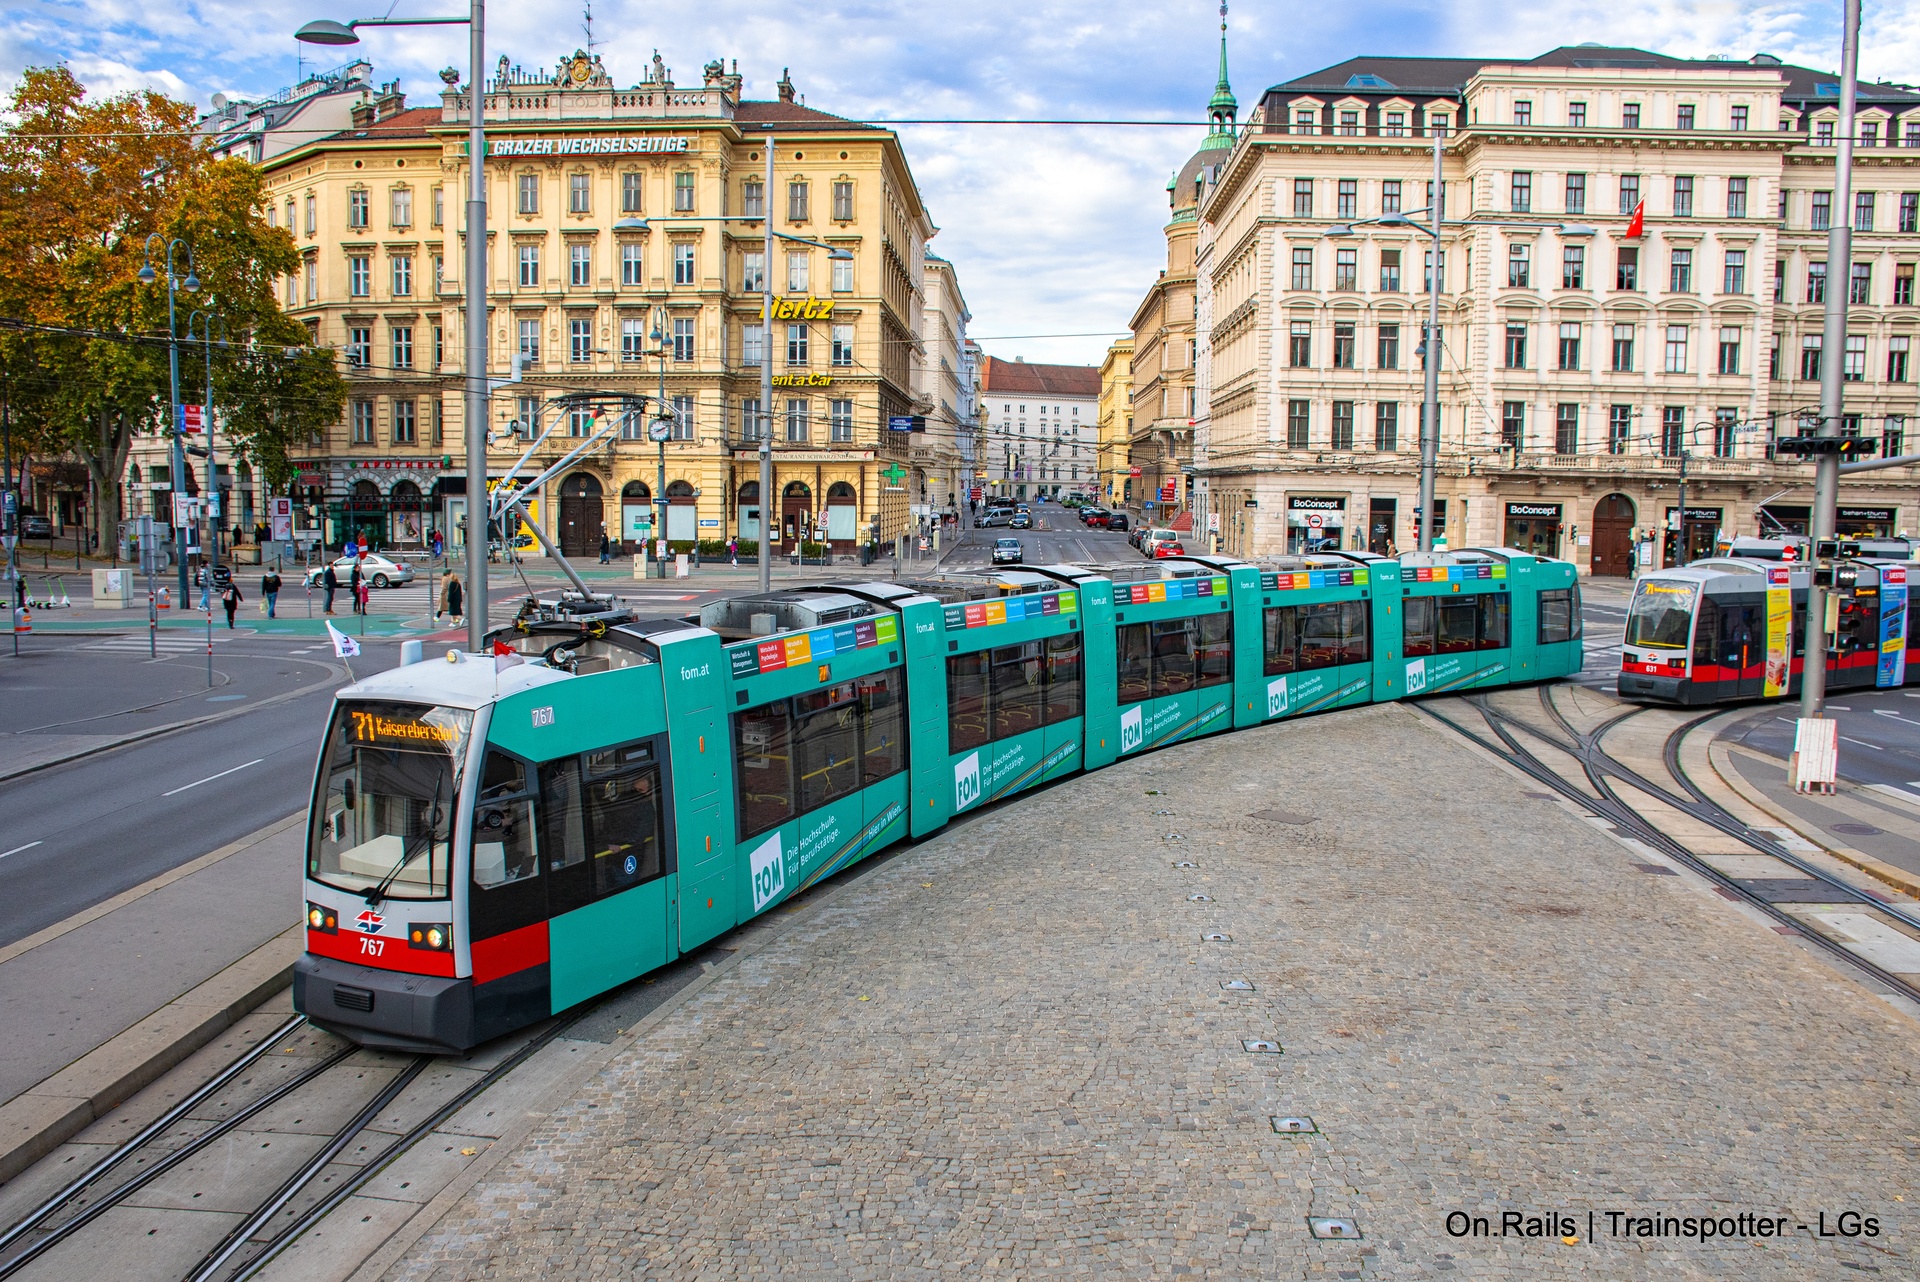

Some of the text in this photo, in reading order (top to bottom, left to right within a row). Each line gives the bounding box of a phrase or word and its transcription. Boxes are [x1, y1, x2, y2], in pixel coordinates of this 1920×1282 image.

[493, 137, 688, 155] GRAZER WECHSELSEITIGE
[771, 373, 834, 387] ent a Car
[362, 460, 445, 470] APOTHEKE
[1293, 499, 1338, 509] BoConcept
[1510, 505, 1557, 516] BoConcept
[1241, 581, 1255, 589] fom.at
[1646, 582, 1654, 594] 71
[1091, 596, 1107, 606] fom.at
[916, 622, 934, 634] fom.at
[681, 663, 710, 680] fom.at
[1646, 665, 1657, 673] 631
[1408, 671, 1424, 690] FOM
[1270, 690, 1286, 713] FOM
[532, 707, 554, 725] 767
[1145, 701, 1179, 725] Die Hochschule.
[1201, 715, 1210, 724] Hier
[352, 711, 459, 742] 71 Kaiserebersdorf
[1123, 721, 1140, 749] FOM
[1145, 726, 1153, 736] Für
[983, 744, 1023, 775] Die Hochschule.
[1048, 757, 1058, 768] Hier
[1058, 752, 1063, 761] in
[983, 754, 1025, 788] Für Berufstätige.
[957, 770, 978, 806] FOM
[868, 804, 902, 840] Hier in Wien.
[787, 814, 837, 861] Die Hochschule.
[788, 828, 840, 877] Für Berufstätige.
[754, 857, 782, 905] FOM
[359, 937, 385, 957] 767
